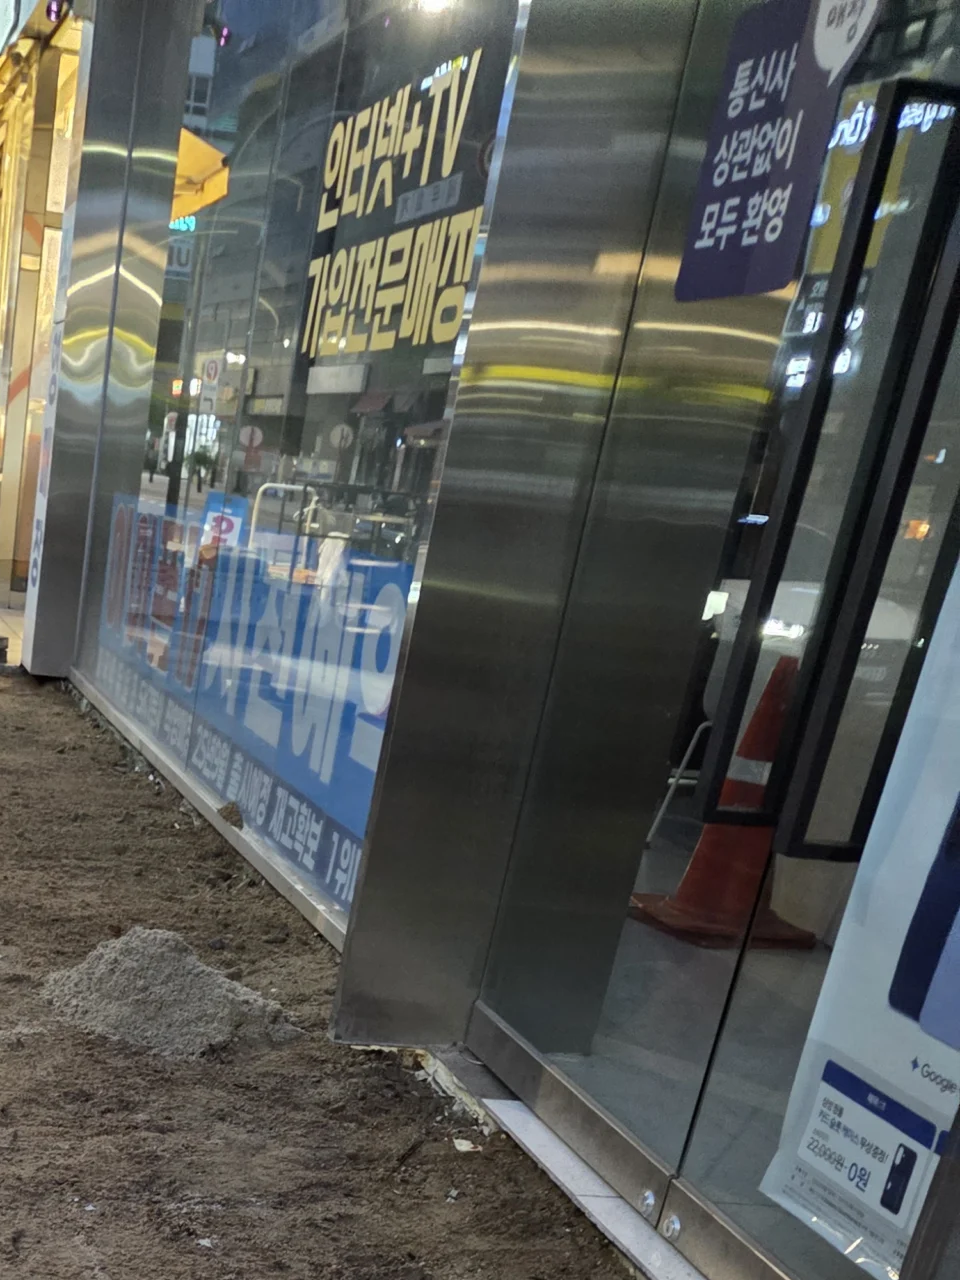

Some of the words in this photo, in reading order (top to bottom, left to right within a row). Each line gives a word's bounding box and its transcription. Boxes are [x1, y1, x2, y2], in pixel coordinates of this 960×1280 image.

[727, 42, 798, 119] 통신사
[317, 47, 483, 233] 인터넷+TV
[712, 108, 804, 188] 상관없이
[693, 197, 741, 251] 모두
[740, 182, 793, 247] 환영
[300, 204, 484, 359] 가입전문매장
[226, 751, 274, 827] 출시예정
[268, 785, 324, 872] 재고확보
[920, 1062, 957, 1095] Google
[847, 1162, 872, 1193] 0원
